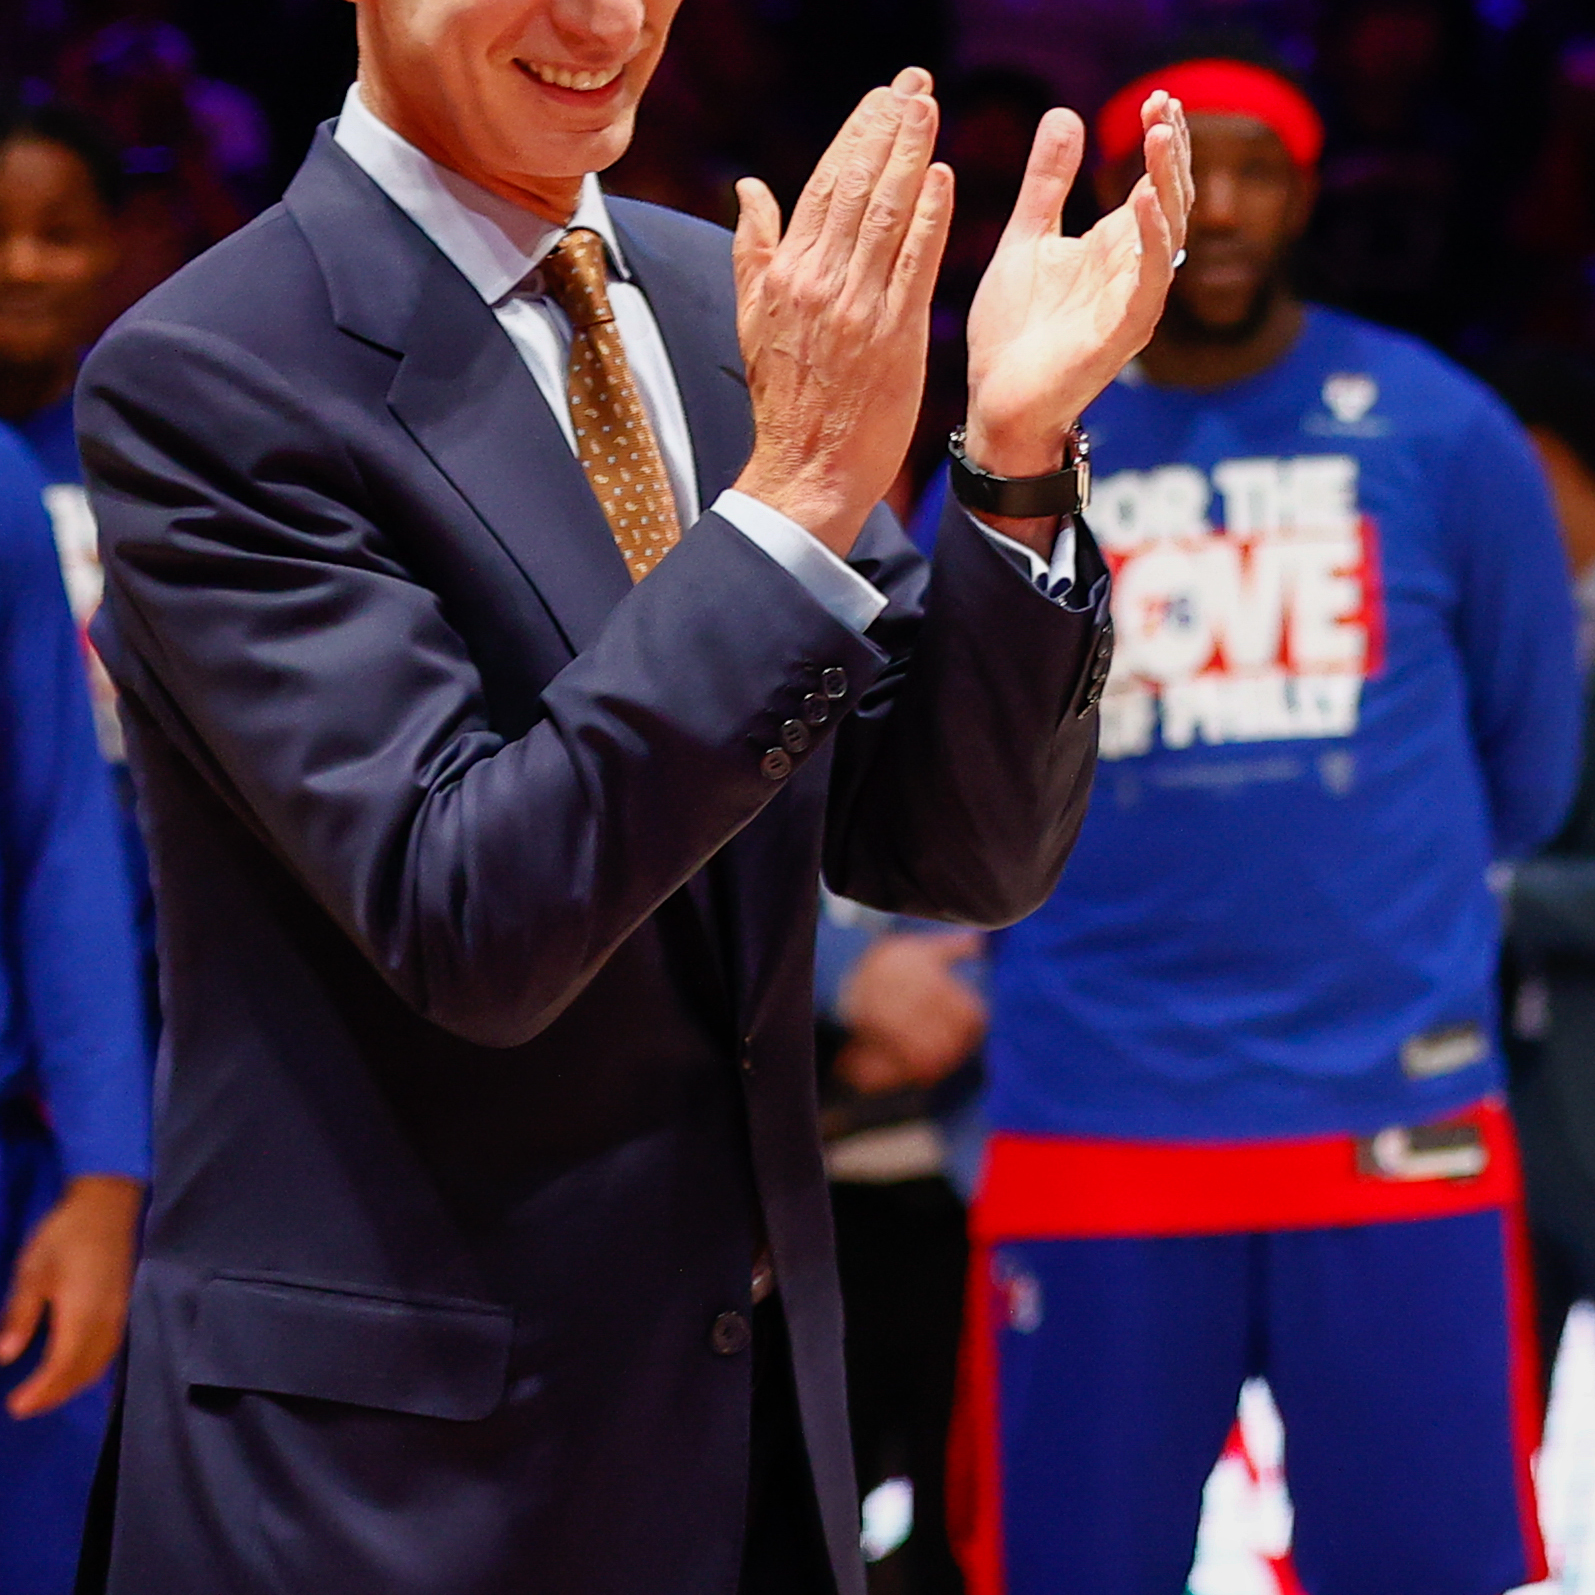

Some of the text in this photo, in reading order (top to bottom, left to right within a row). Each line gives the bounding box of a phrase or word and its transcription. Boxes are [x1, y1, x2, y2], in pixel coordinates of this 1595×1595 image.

[1089, 455, 1357, 551] OR THE
[1098, 541, 1368, 695] OVE
